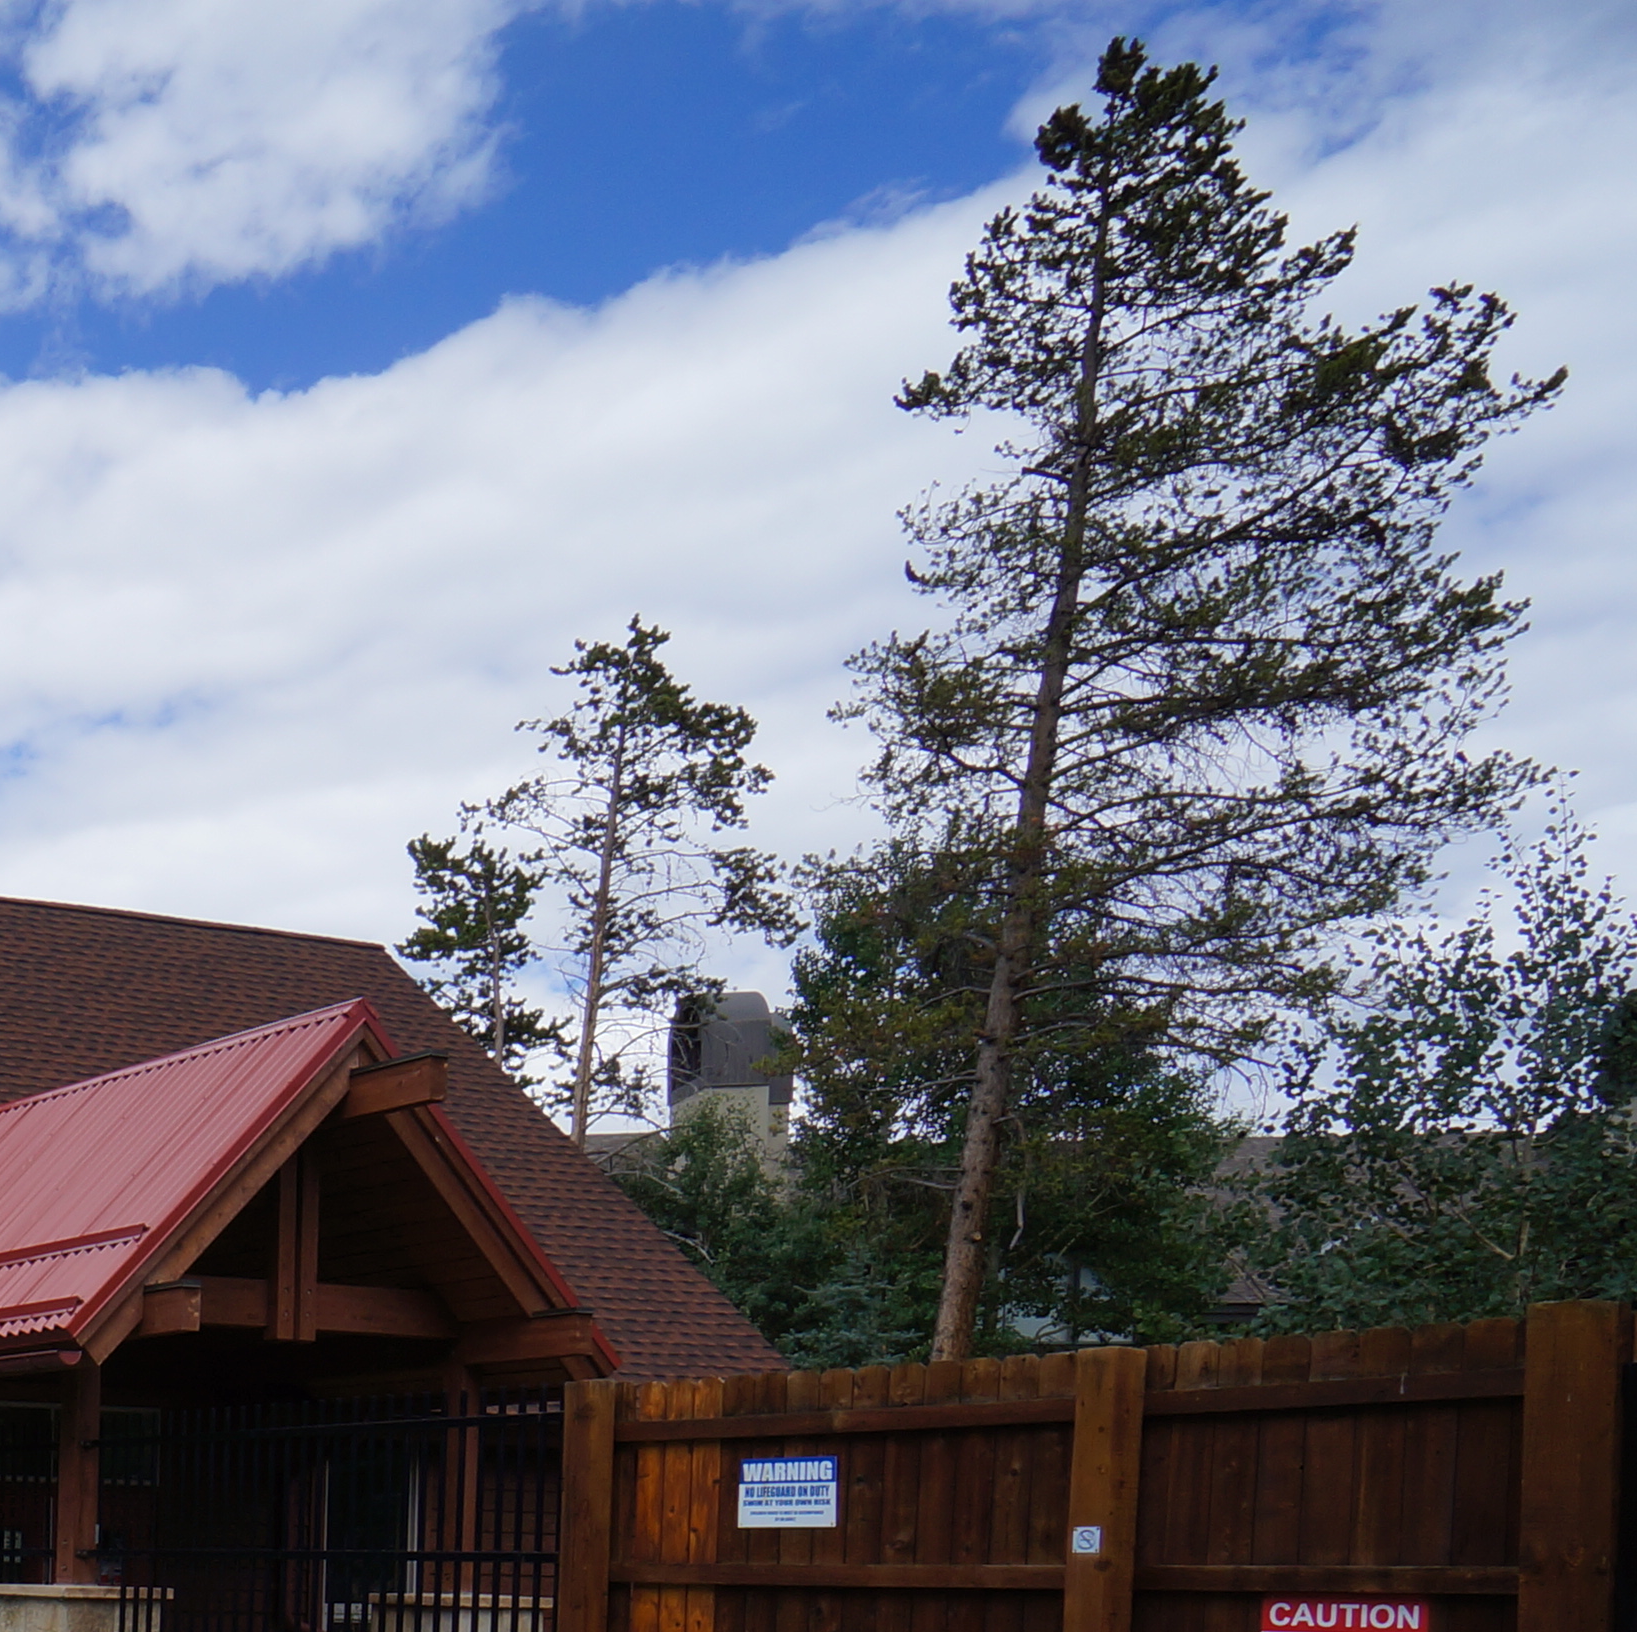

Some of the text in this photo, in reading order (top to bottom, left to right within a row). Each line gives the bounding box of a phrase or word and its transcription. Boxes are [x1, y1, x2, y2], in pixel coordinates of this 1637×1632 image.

[742, 1460, 833, 1482] WARNING
[744, 1485, 830, 1498] NO LIFEGUARD ON DUTY
[1268, 1602, 1420, 1630] CAUTION
